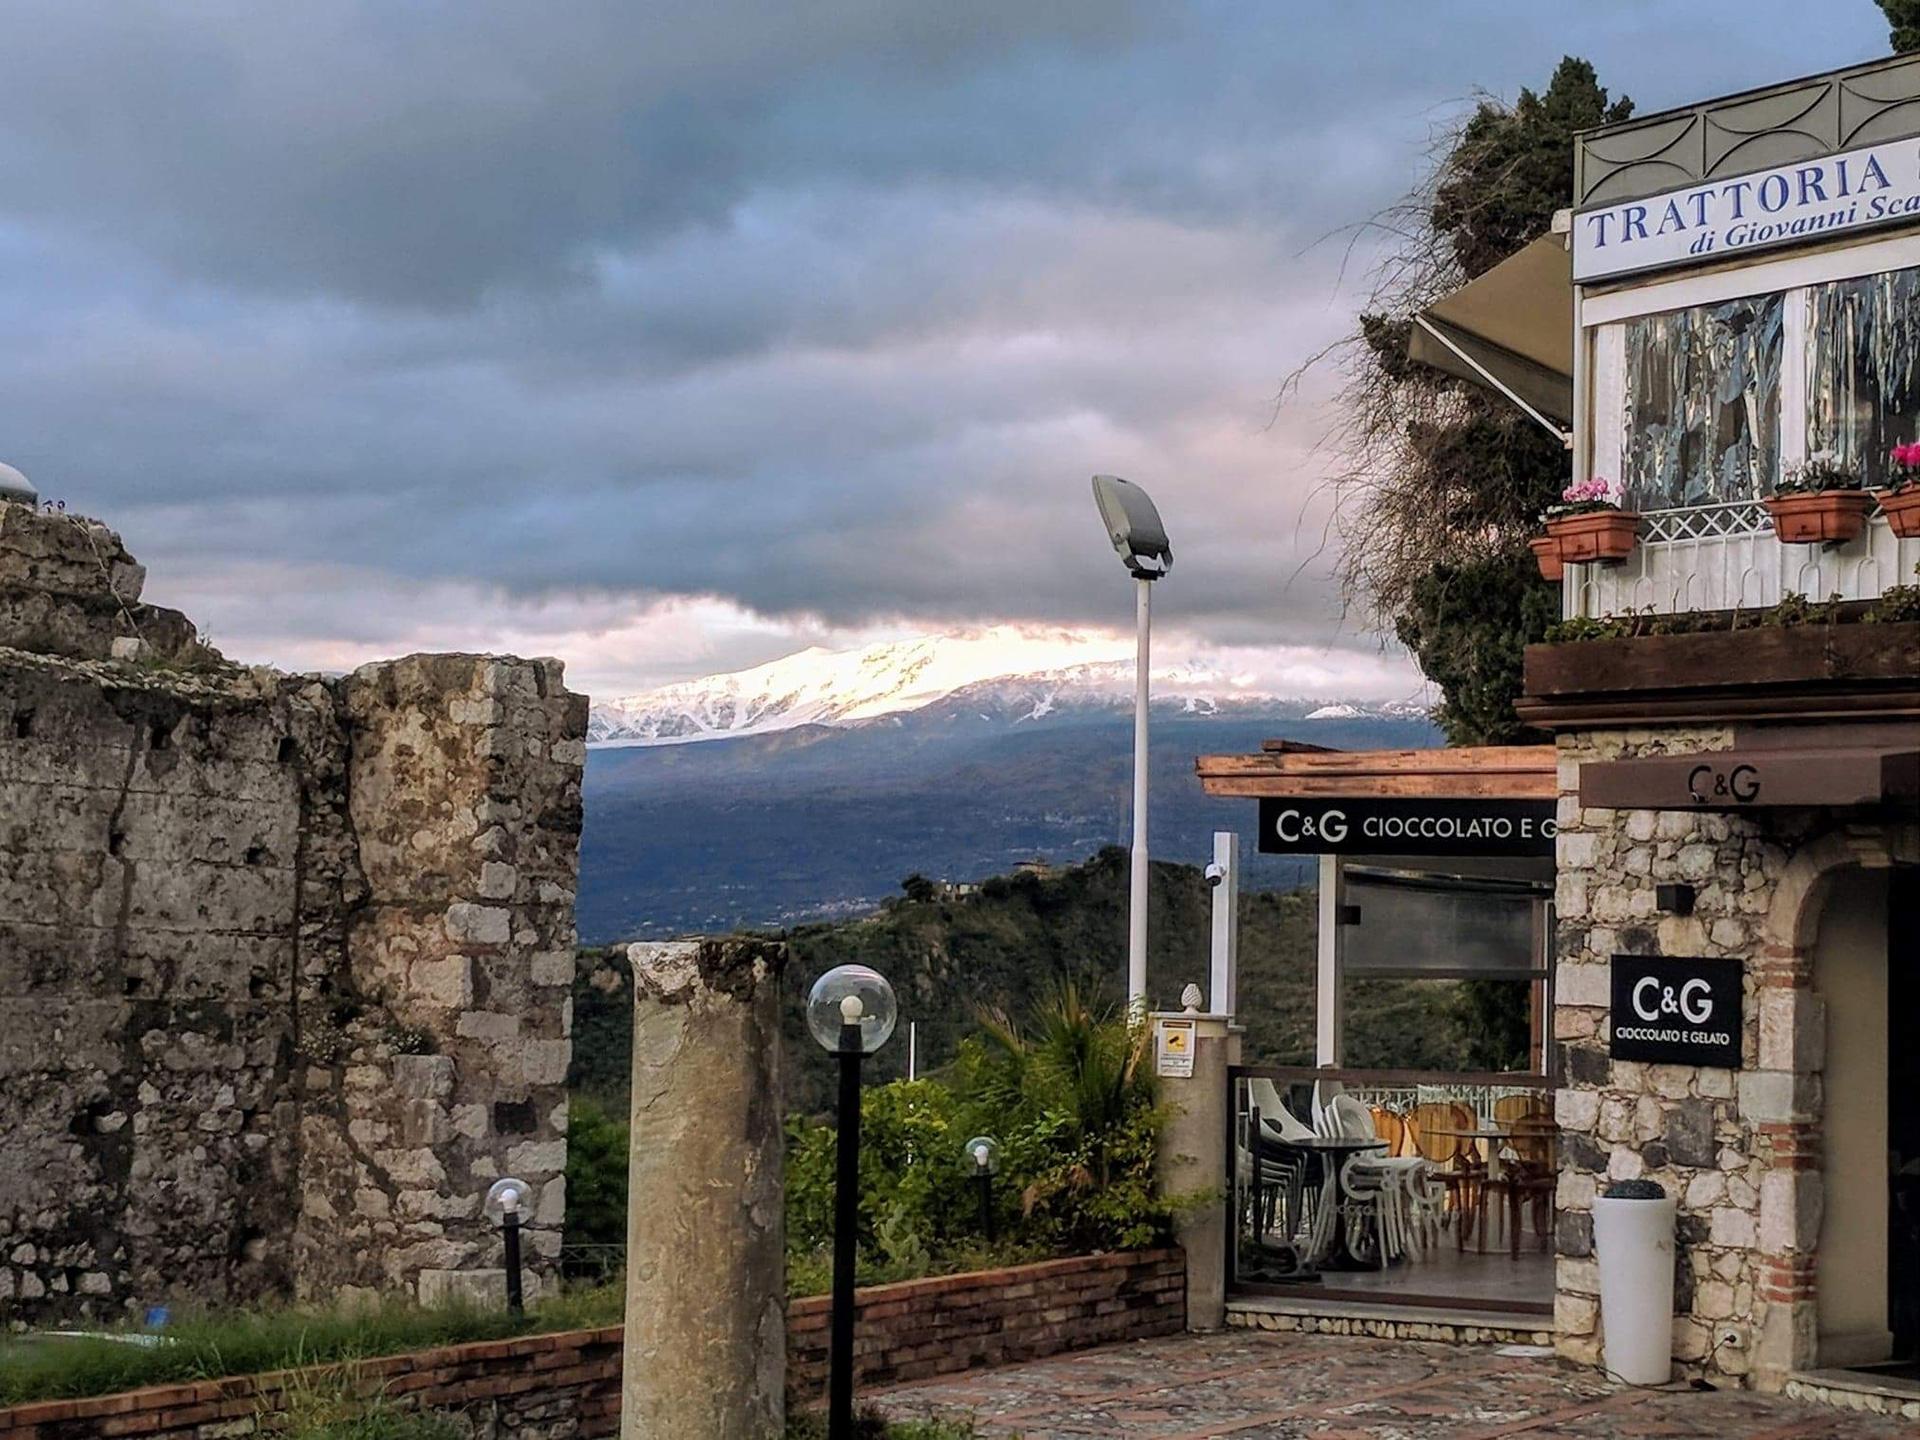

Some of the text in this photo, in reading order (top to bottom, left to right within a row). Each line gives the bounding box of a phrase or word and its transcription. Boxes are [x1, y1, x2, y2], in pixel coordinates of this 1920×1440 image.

[1587, 153, 1892, 249] TRATTORIA
[1689, 195, 1920, 256] di Giovanni Sca
[1688, 764, 1761, 803] C&G
[1276, 809, 1348, 842] C&G
[1363, 817, 1511, 838] CIOCCOLATO
[1521, 818, 1532, 838] E
[1632, 976, 1713, 1024] C&G
[1616, 1027, 1730, 1045] CIOCCOLATO E GELATO
